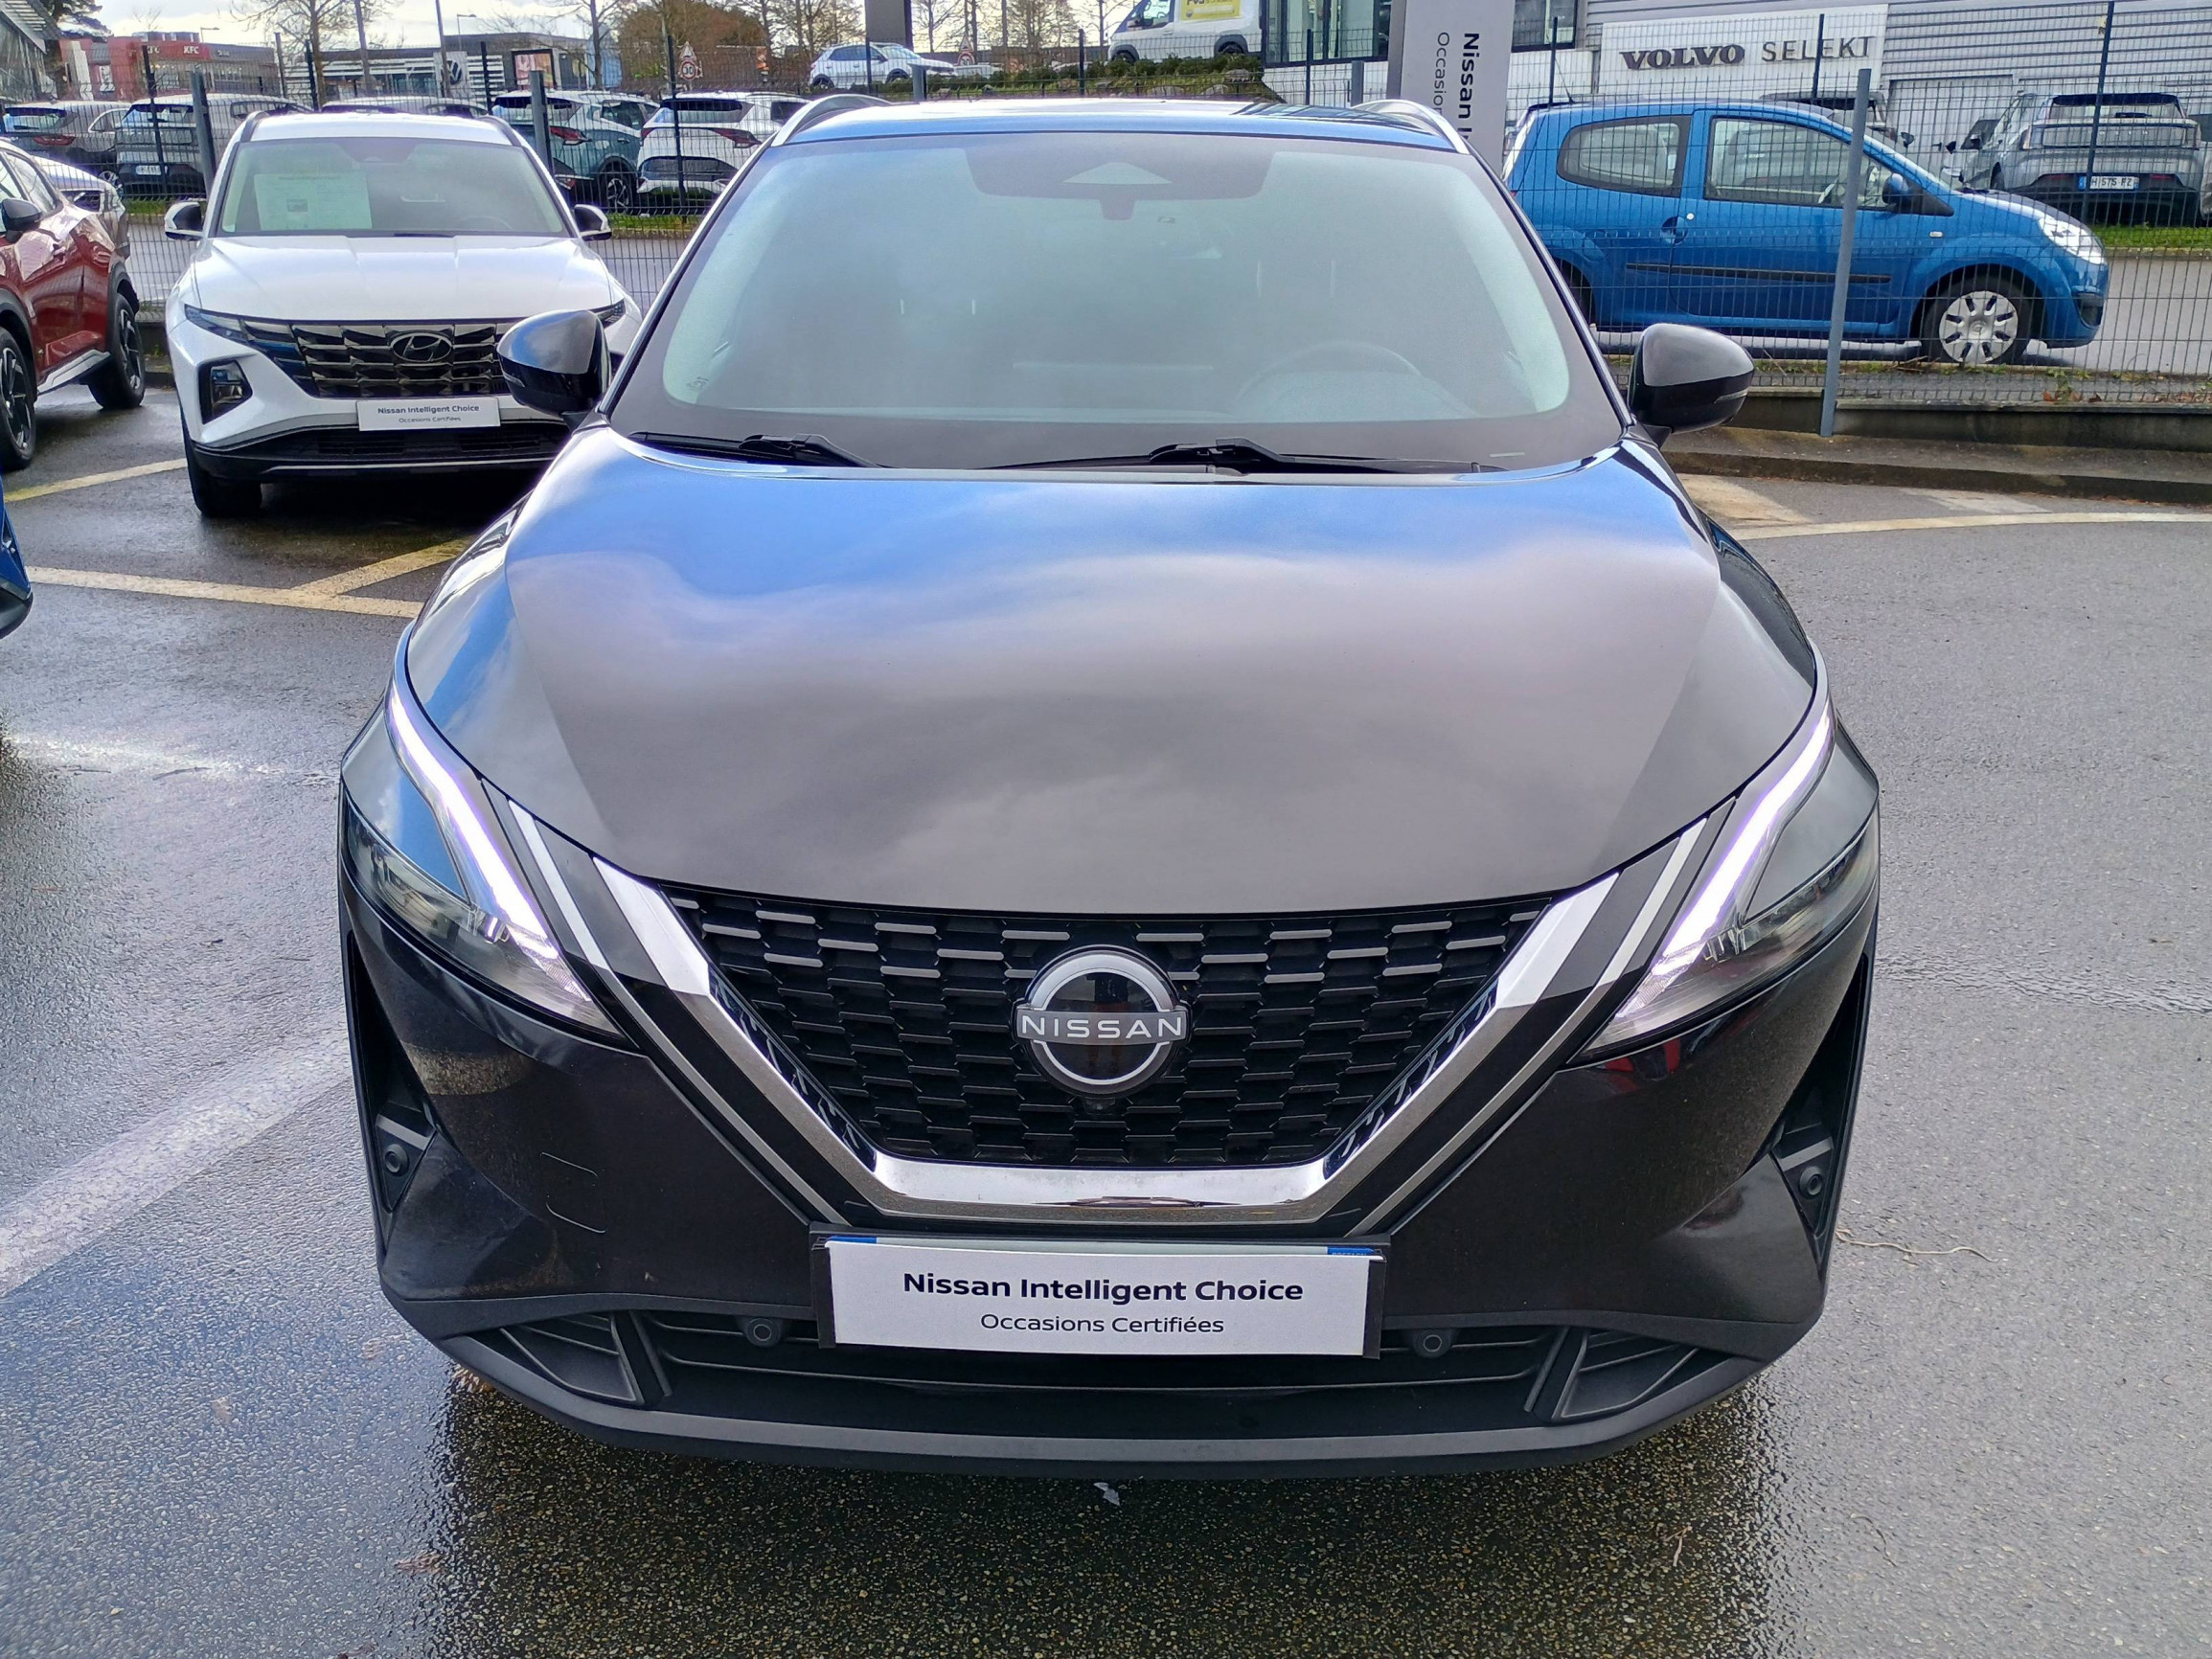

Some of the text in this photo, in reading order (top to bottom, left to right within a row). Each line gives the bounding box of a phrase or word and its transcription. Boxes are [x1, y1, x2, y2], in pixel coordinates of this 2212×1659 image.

[183, 45, 199, 55] KFC
[1619, 35, 1877, 71] VOLVO SELEKT
[1458, 33, 1480, 119] Nissan
[1021, 1015, 1181, 1039] NISSAN
[903, 1273, 1304, 1305] Nissan Intelligent Choice
[980, 1313, 1224, 1333] Occasions Certifiées
